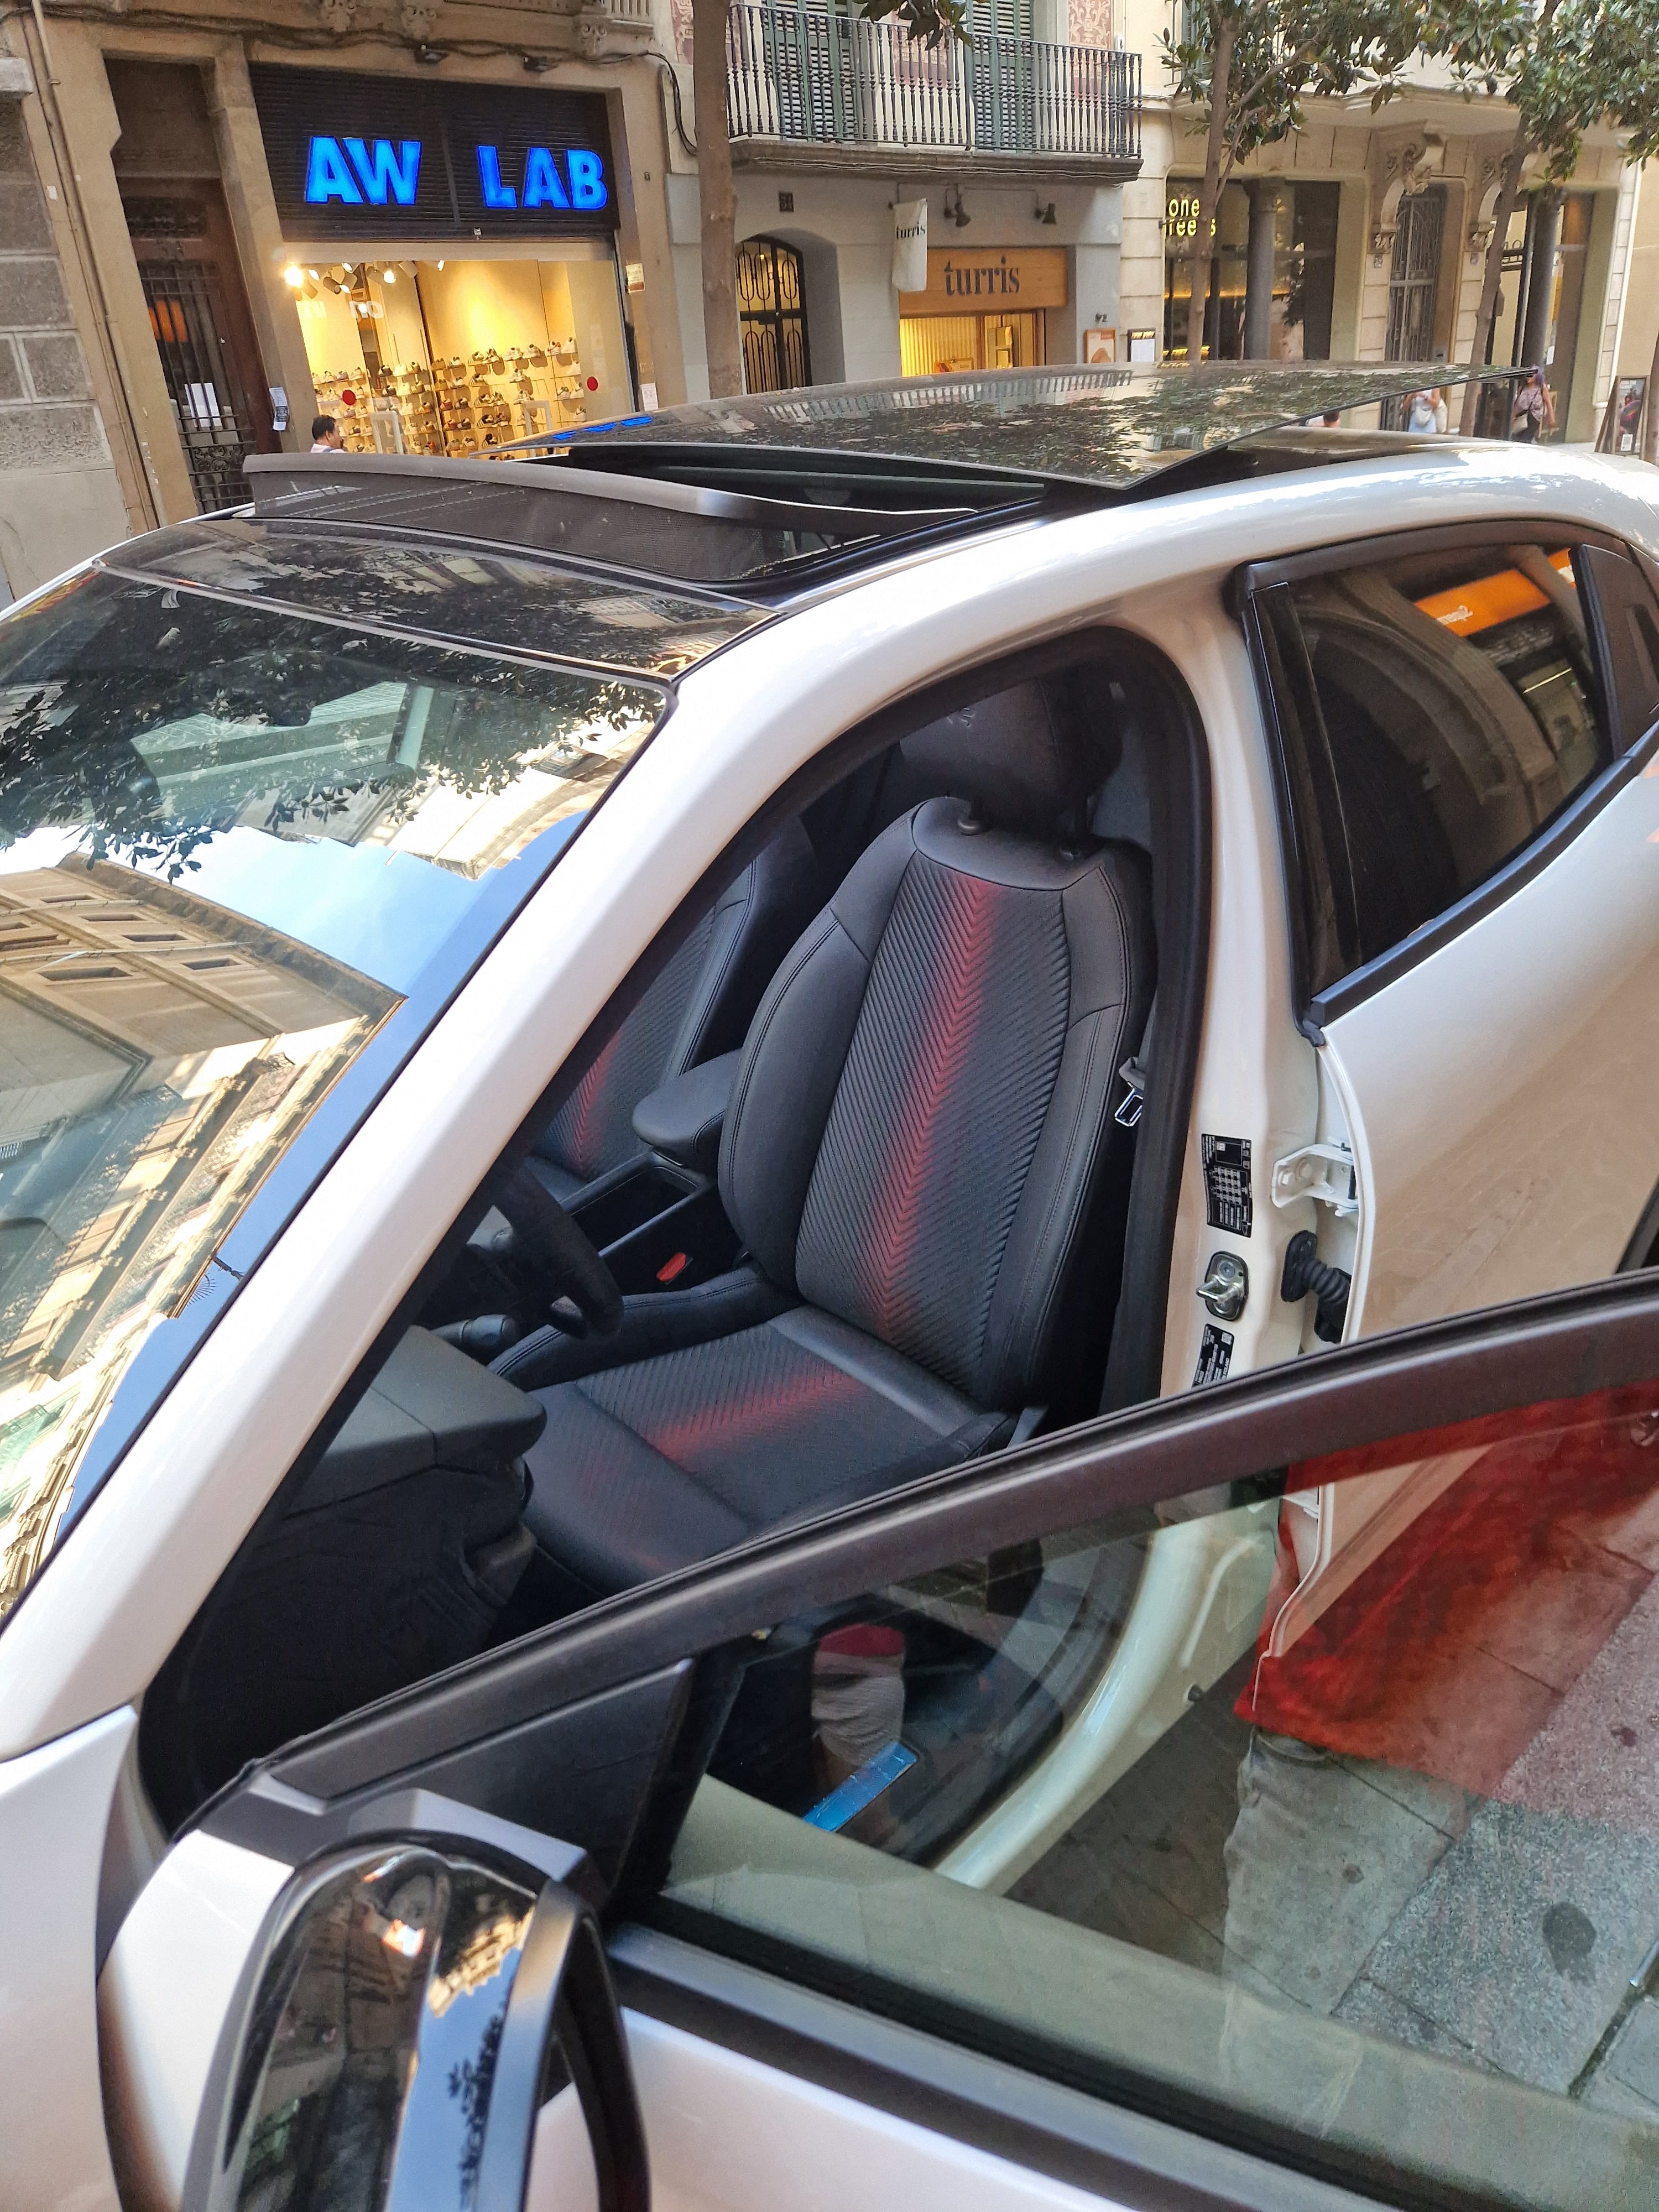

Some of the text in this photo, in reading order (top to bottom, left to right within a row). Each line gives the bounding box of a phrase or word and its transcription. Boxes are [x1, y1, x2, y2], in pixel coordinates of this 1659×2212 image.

[305, 135, 607, 210] AW LAB
[896, 222, 926, 239] turris
[944, 254, 1020, 296] turris
